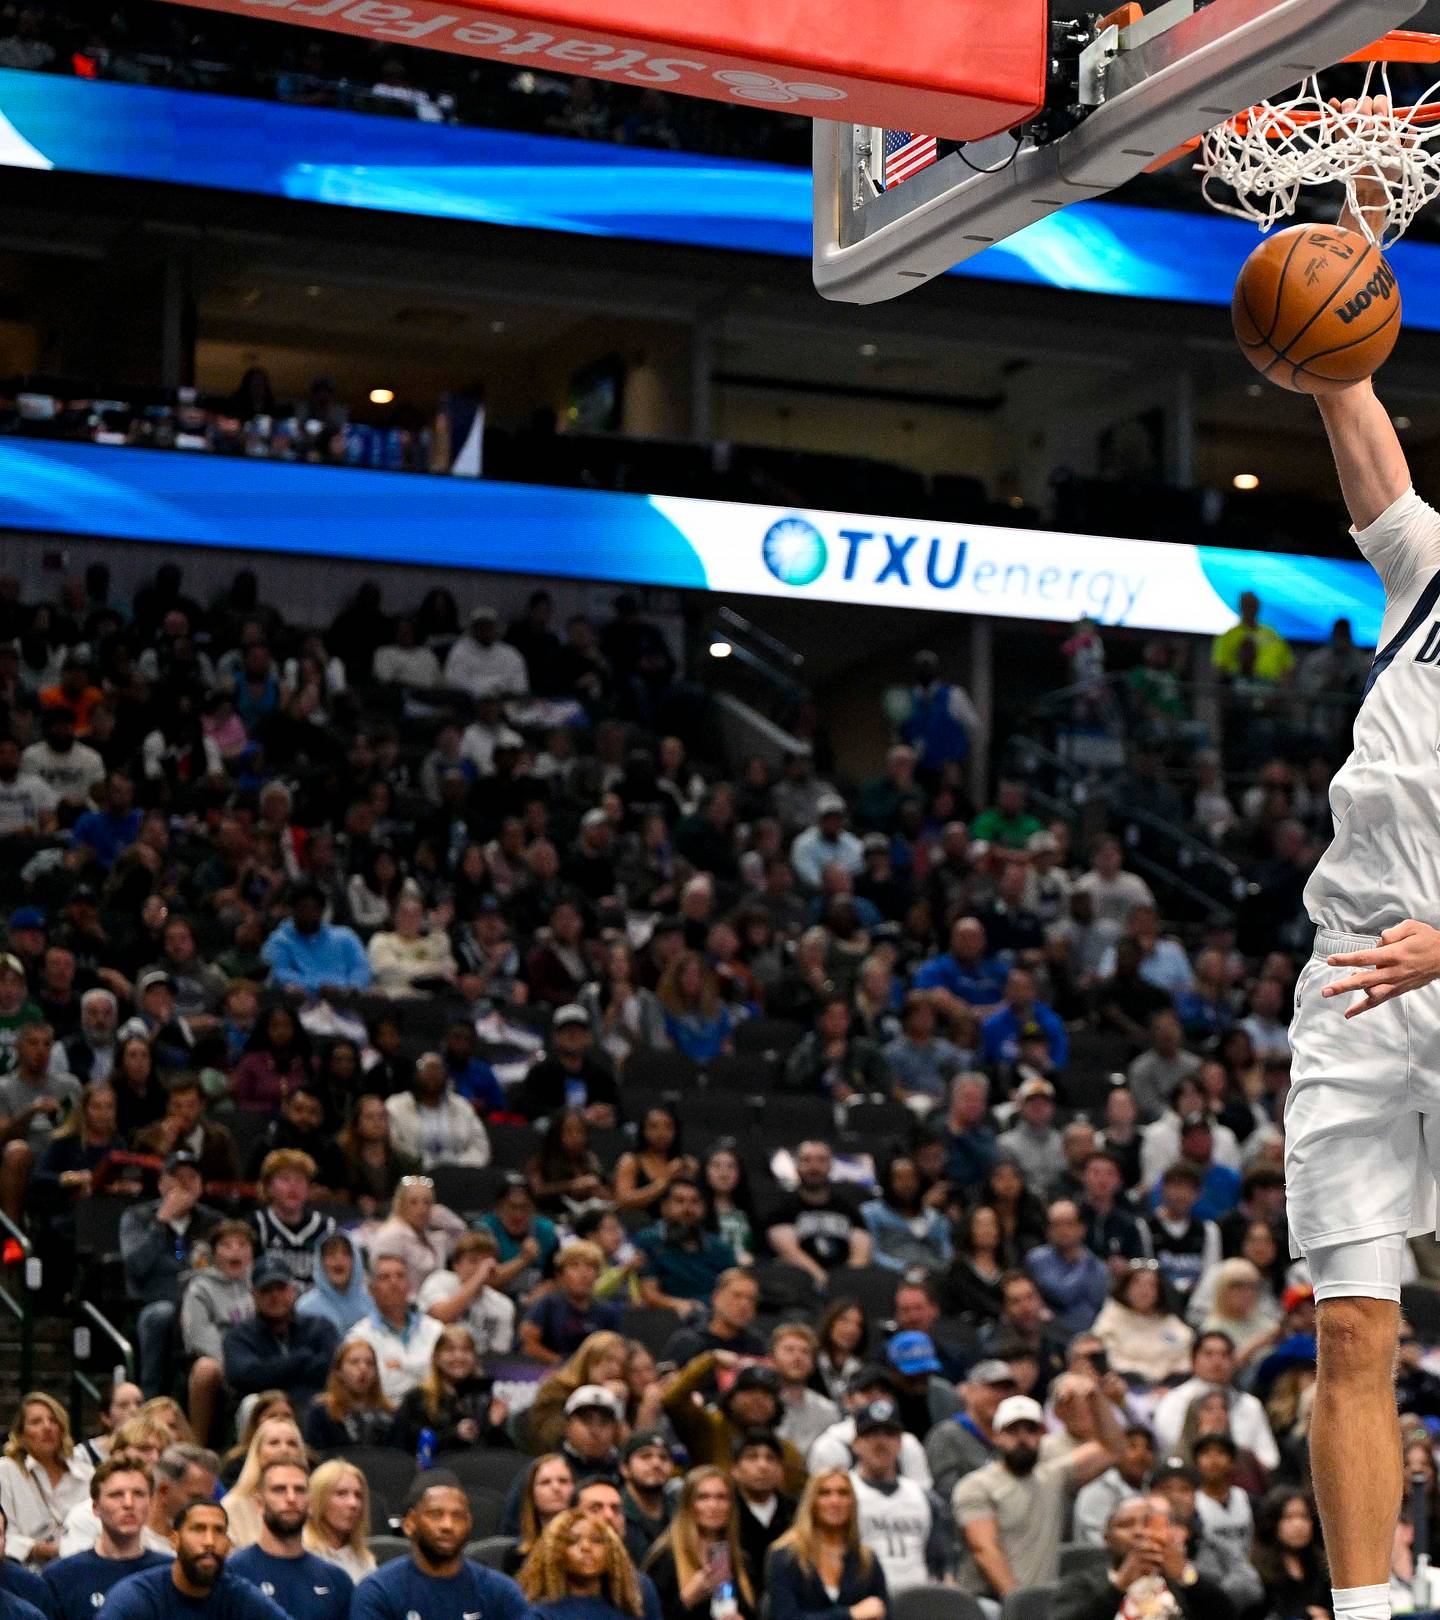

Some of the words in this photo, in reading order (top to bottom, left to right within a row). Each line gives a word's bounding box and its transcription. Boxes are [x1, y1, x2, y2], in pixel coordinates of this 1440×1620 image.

[1334, 256, 1397, 324] ilson
[838, 529, 969, 590] TXU
[971, 559, 1147, 625] energy
